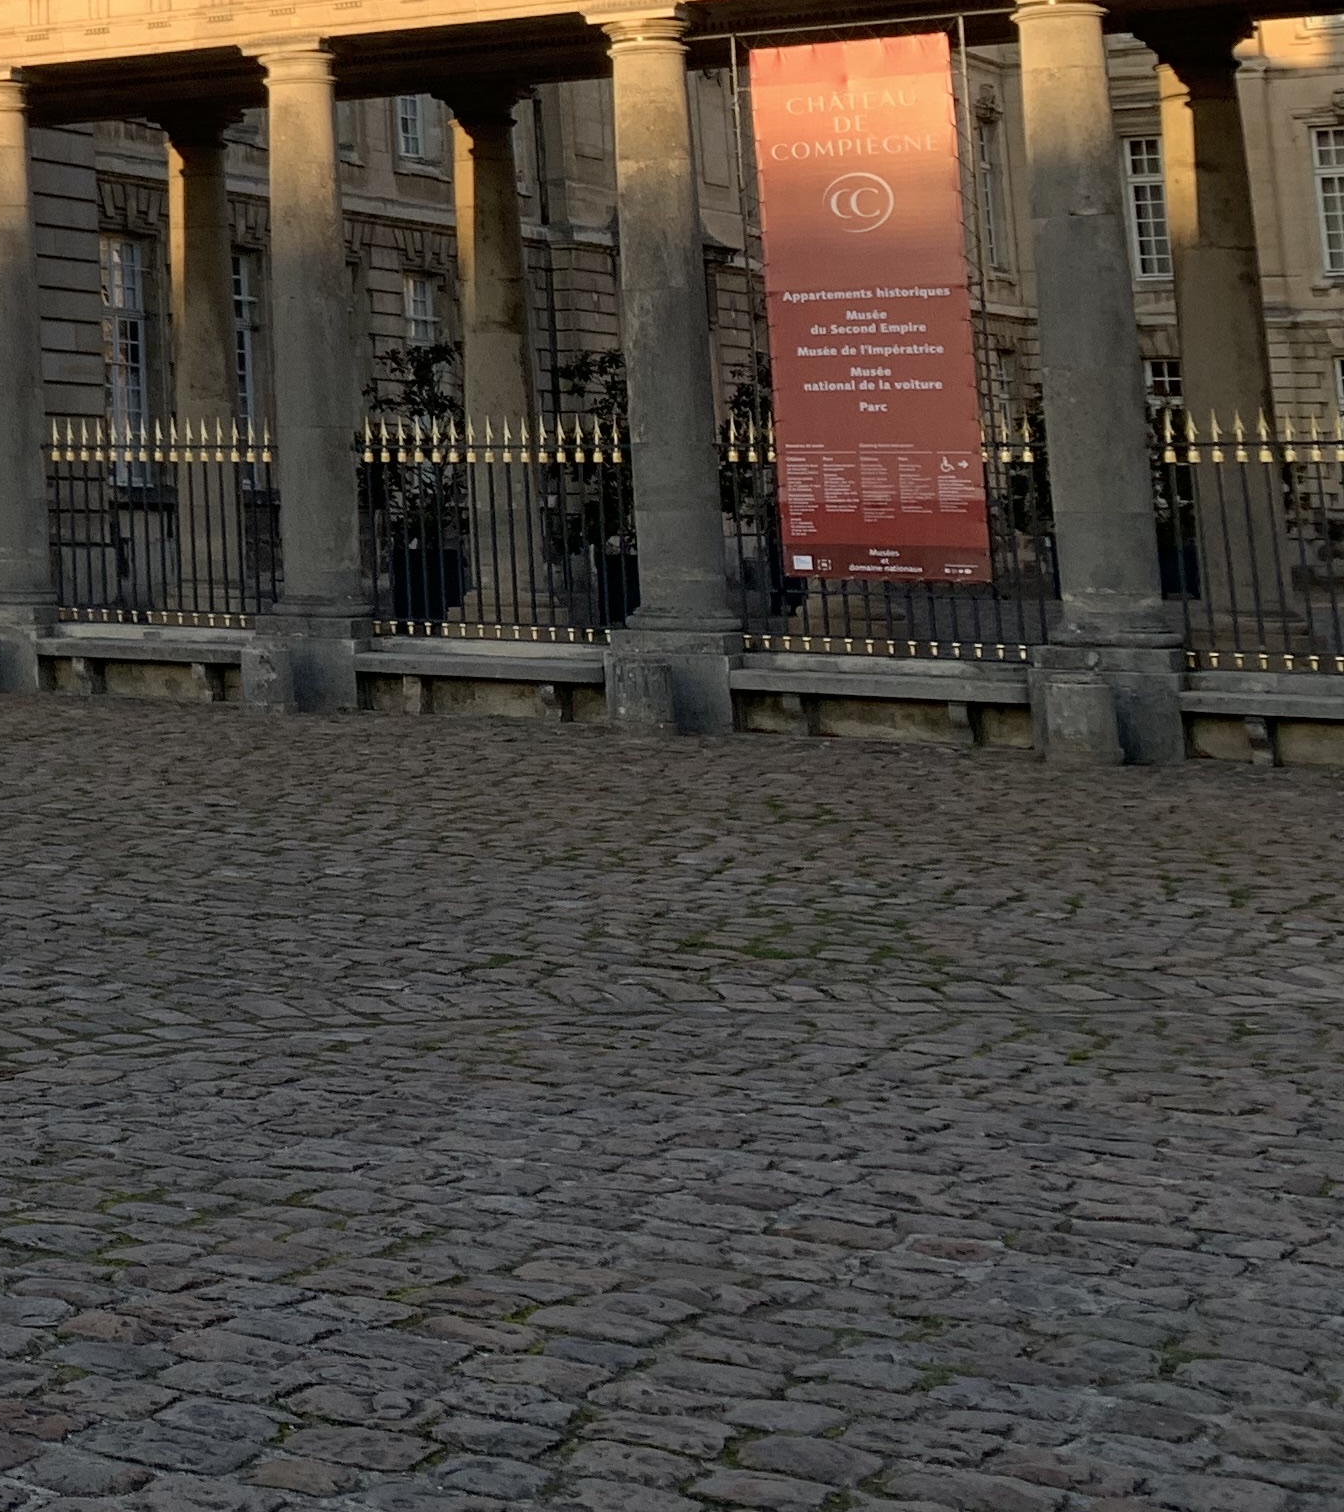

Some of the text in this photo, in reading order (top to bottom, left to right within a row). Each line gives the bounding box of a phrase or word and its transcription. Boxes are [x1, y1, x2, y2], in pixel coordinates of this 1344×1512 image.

[786, 90, 916, 115] CHÂTEAU
[834, 114, 868, 134] DE
[771, 133, 939, 161] COMPIÈGNE
[783, 287, 951, 303] Appartements historiques
[846, 309, 888, 320] Musée
[811, 322, 927, 335] du Second Empire
[797, 343, 945, 357] Musée de l'Impératrice
[850, 366, 892, 377] Musée
[804, 379, 943, 391] national de la voiture
[859, 402, 888, 412] Parc
